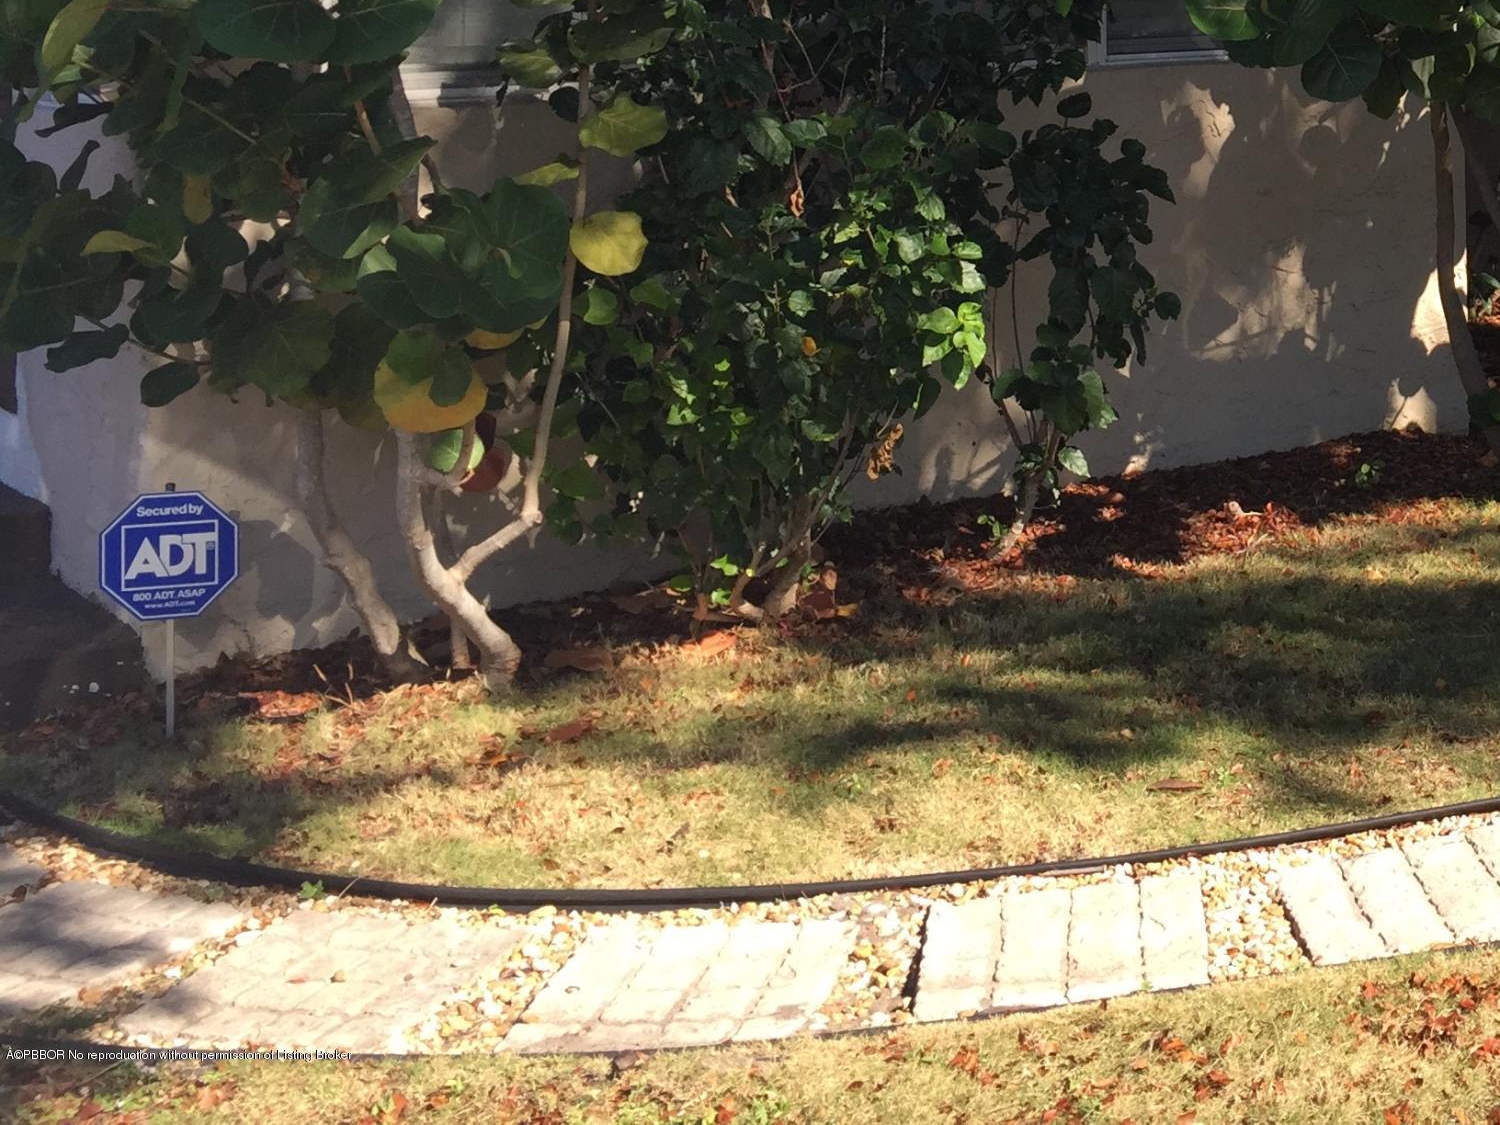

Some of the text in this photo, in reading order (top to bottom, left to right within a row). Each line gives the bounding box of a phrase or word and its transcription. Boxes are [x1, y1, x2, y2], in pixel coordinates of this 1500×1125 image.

[136, 503, 203, 517] Secured by
[124, 532, 216, 579] ADT
